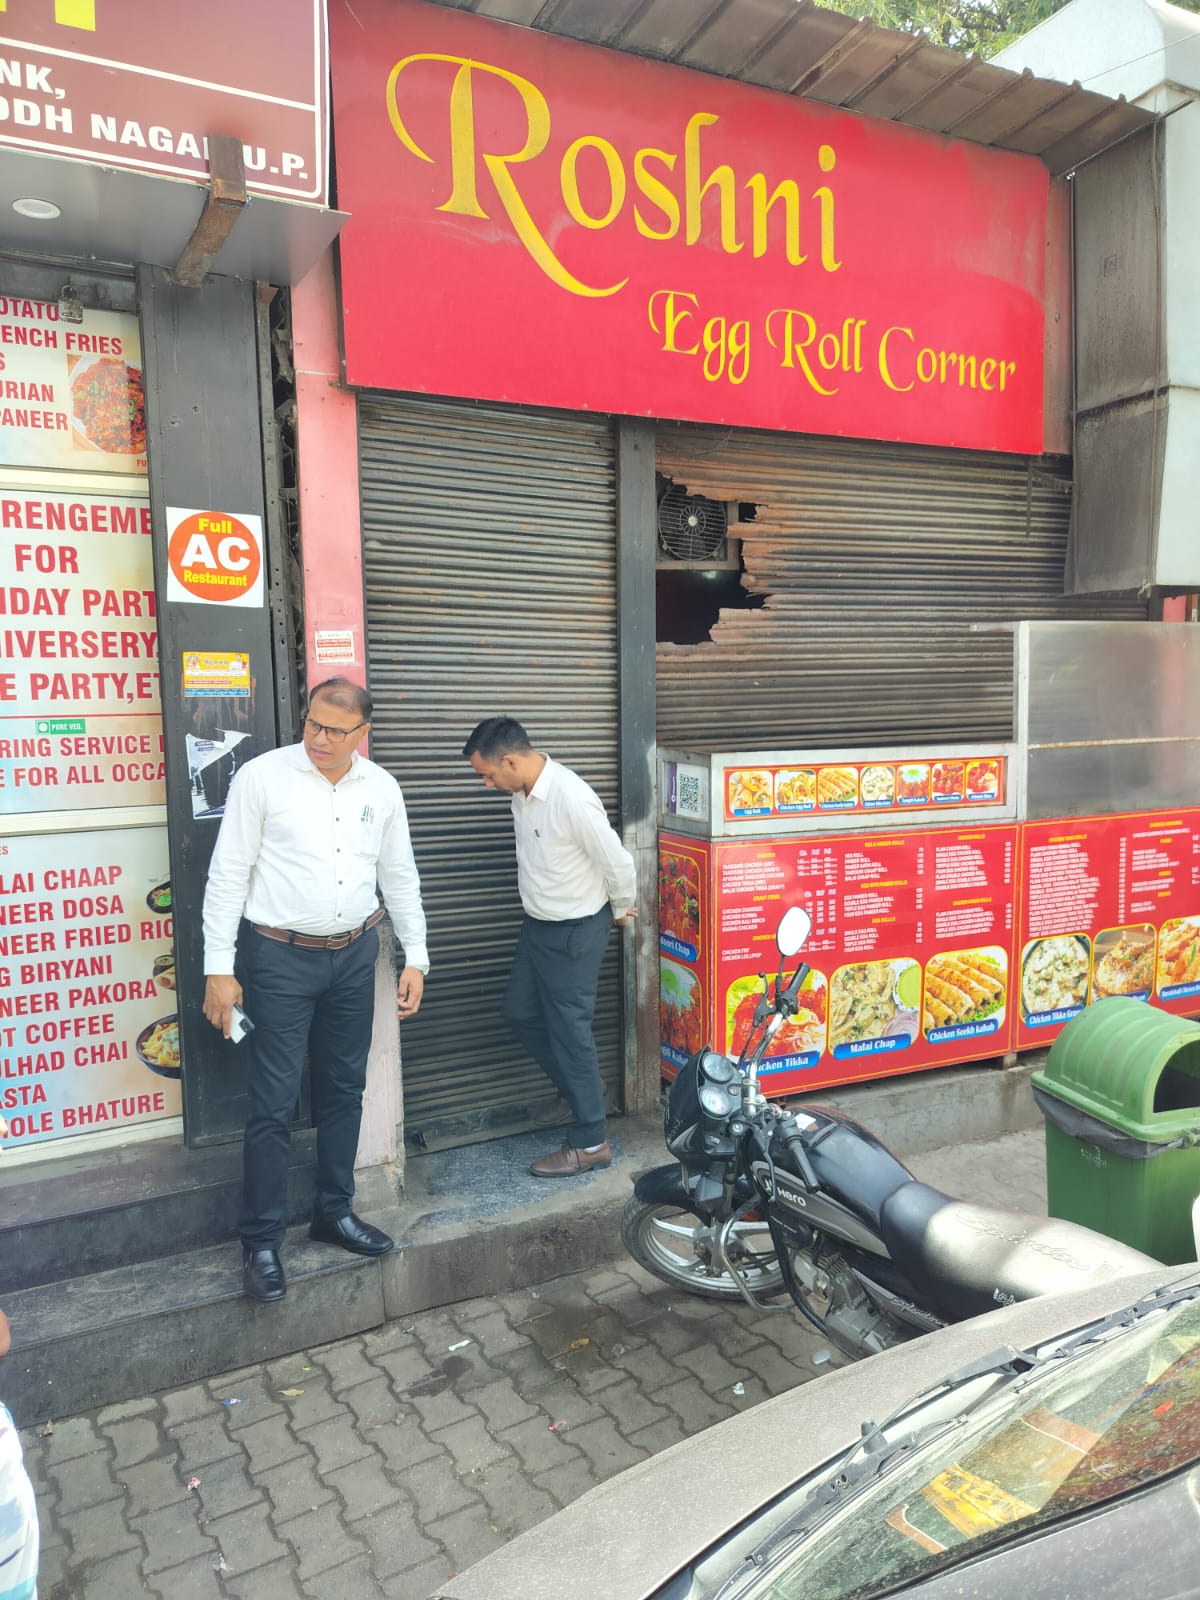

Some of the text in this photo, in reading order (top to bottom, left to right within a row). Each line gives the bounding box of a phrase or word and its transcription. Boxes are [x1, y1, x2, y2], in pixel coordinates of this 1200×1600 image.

[91, 113, 209, 160] NAGA
[243, 145, 309, 180] U.P.
[385, 53, 843, 298] Roshni
[66, 332, 123, 355] FRIES
[648, 290, 1017, 396] Egg Roll Corner
[0, 408, 69, 430] ANEER
[198, 518, 233, 534] Full
[14, 544, 79, 573] FOR
[180, 533, 251, 572] AC
[183, 570, 248, 587] Restaurant
[60, 735, 151, 757] SERVICE
[14, 766, 59, 787] FOR
[67, 765, 105, 785] ALL
[44, 865, 123, 891] CHAAP
[63, 894, 125, 919] DOSA
[65, 923, 132, 949] FRIED
[20, 955, 113, 985] BIRYANI
[69, 979, 158, 1008] PAKORA
[25, 1013, 115, 1045] COFFEE
[929, 1028, 955, 1041] Chicken
[956, 1025, 975, 1037] Seekh
[74, 1041, 128, 1067] CHAI
[851, 1038, 896, 1053] Malai Chap
[785, 1057, 809, 1068] Tikka
[0, 1084, 47, 1110] STA
[63, 1092, 165, 1128] BHATURE
[777, 1186, 806, 1207] Hero
